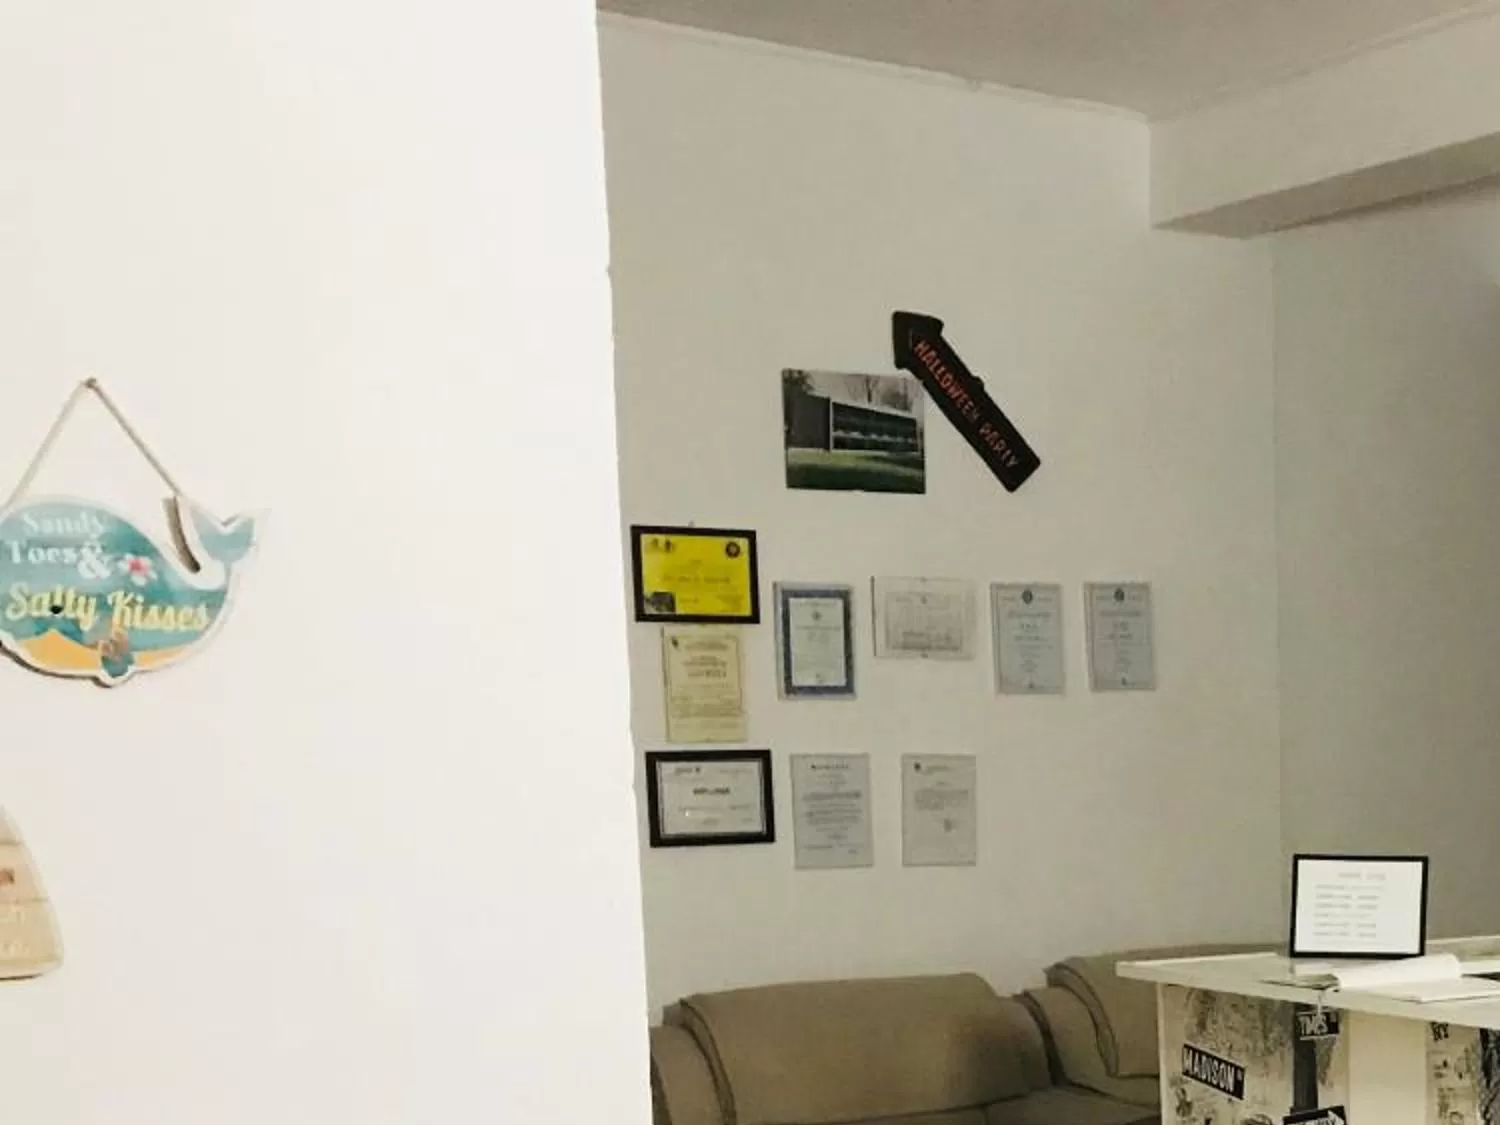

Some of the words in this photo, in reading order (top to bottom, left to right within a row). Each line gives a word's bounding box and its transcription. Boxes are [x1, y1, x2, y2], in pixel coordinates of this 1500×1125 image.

[914, 340, 980, 424] HALLOWEEN
[979, 422, 1018, 468] PARTY
[22, 511, 108, 541] Sandy
[8, 540, 80, 564] Toes
[77, 541, 112, 579] &
[5, 582, 97, 631] Salty
[107, 591, 208, 631] Kisses
[1184, 1048, 1235, 1092] MADISON
